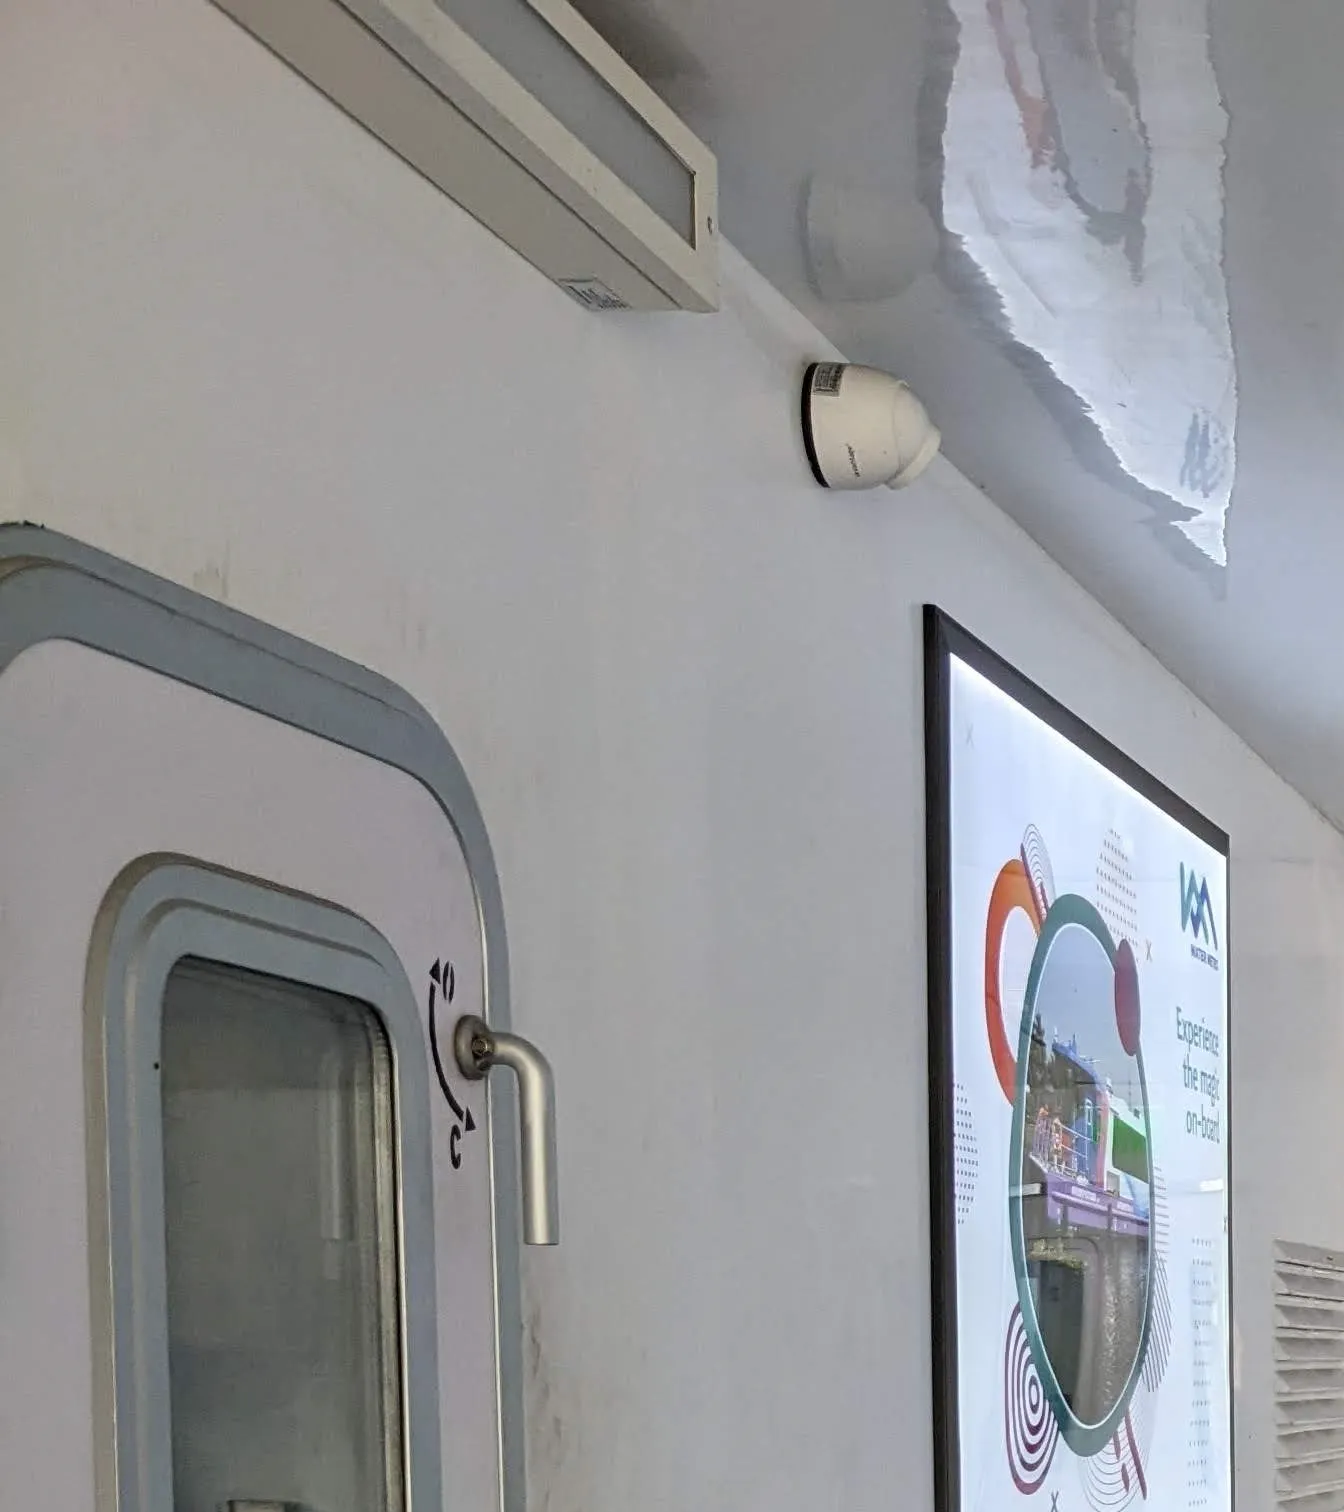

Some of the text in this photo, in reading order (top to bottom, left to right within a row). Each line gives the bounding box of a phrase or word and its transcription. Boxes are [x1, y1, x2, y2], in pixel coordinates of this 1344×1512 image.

[1176, 1005, 1220, 1058] Experience
[1182, 1053, 1198, 1092] the
[1186, 1103, 1221, 1144] on-board
[450, 1124, 462, 1170] C
